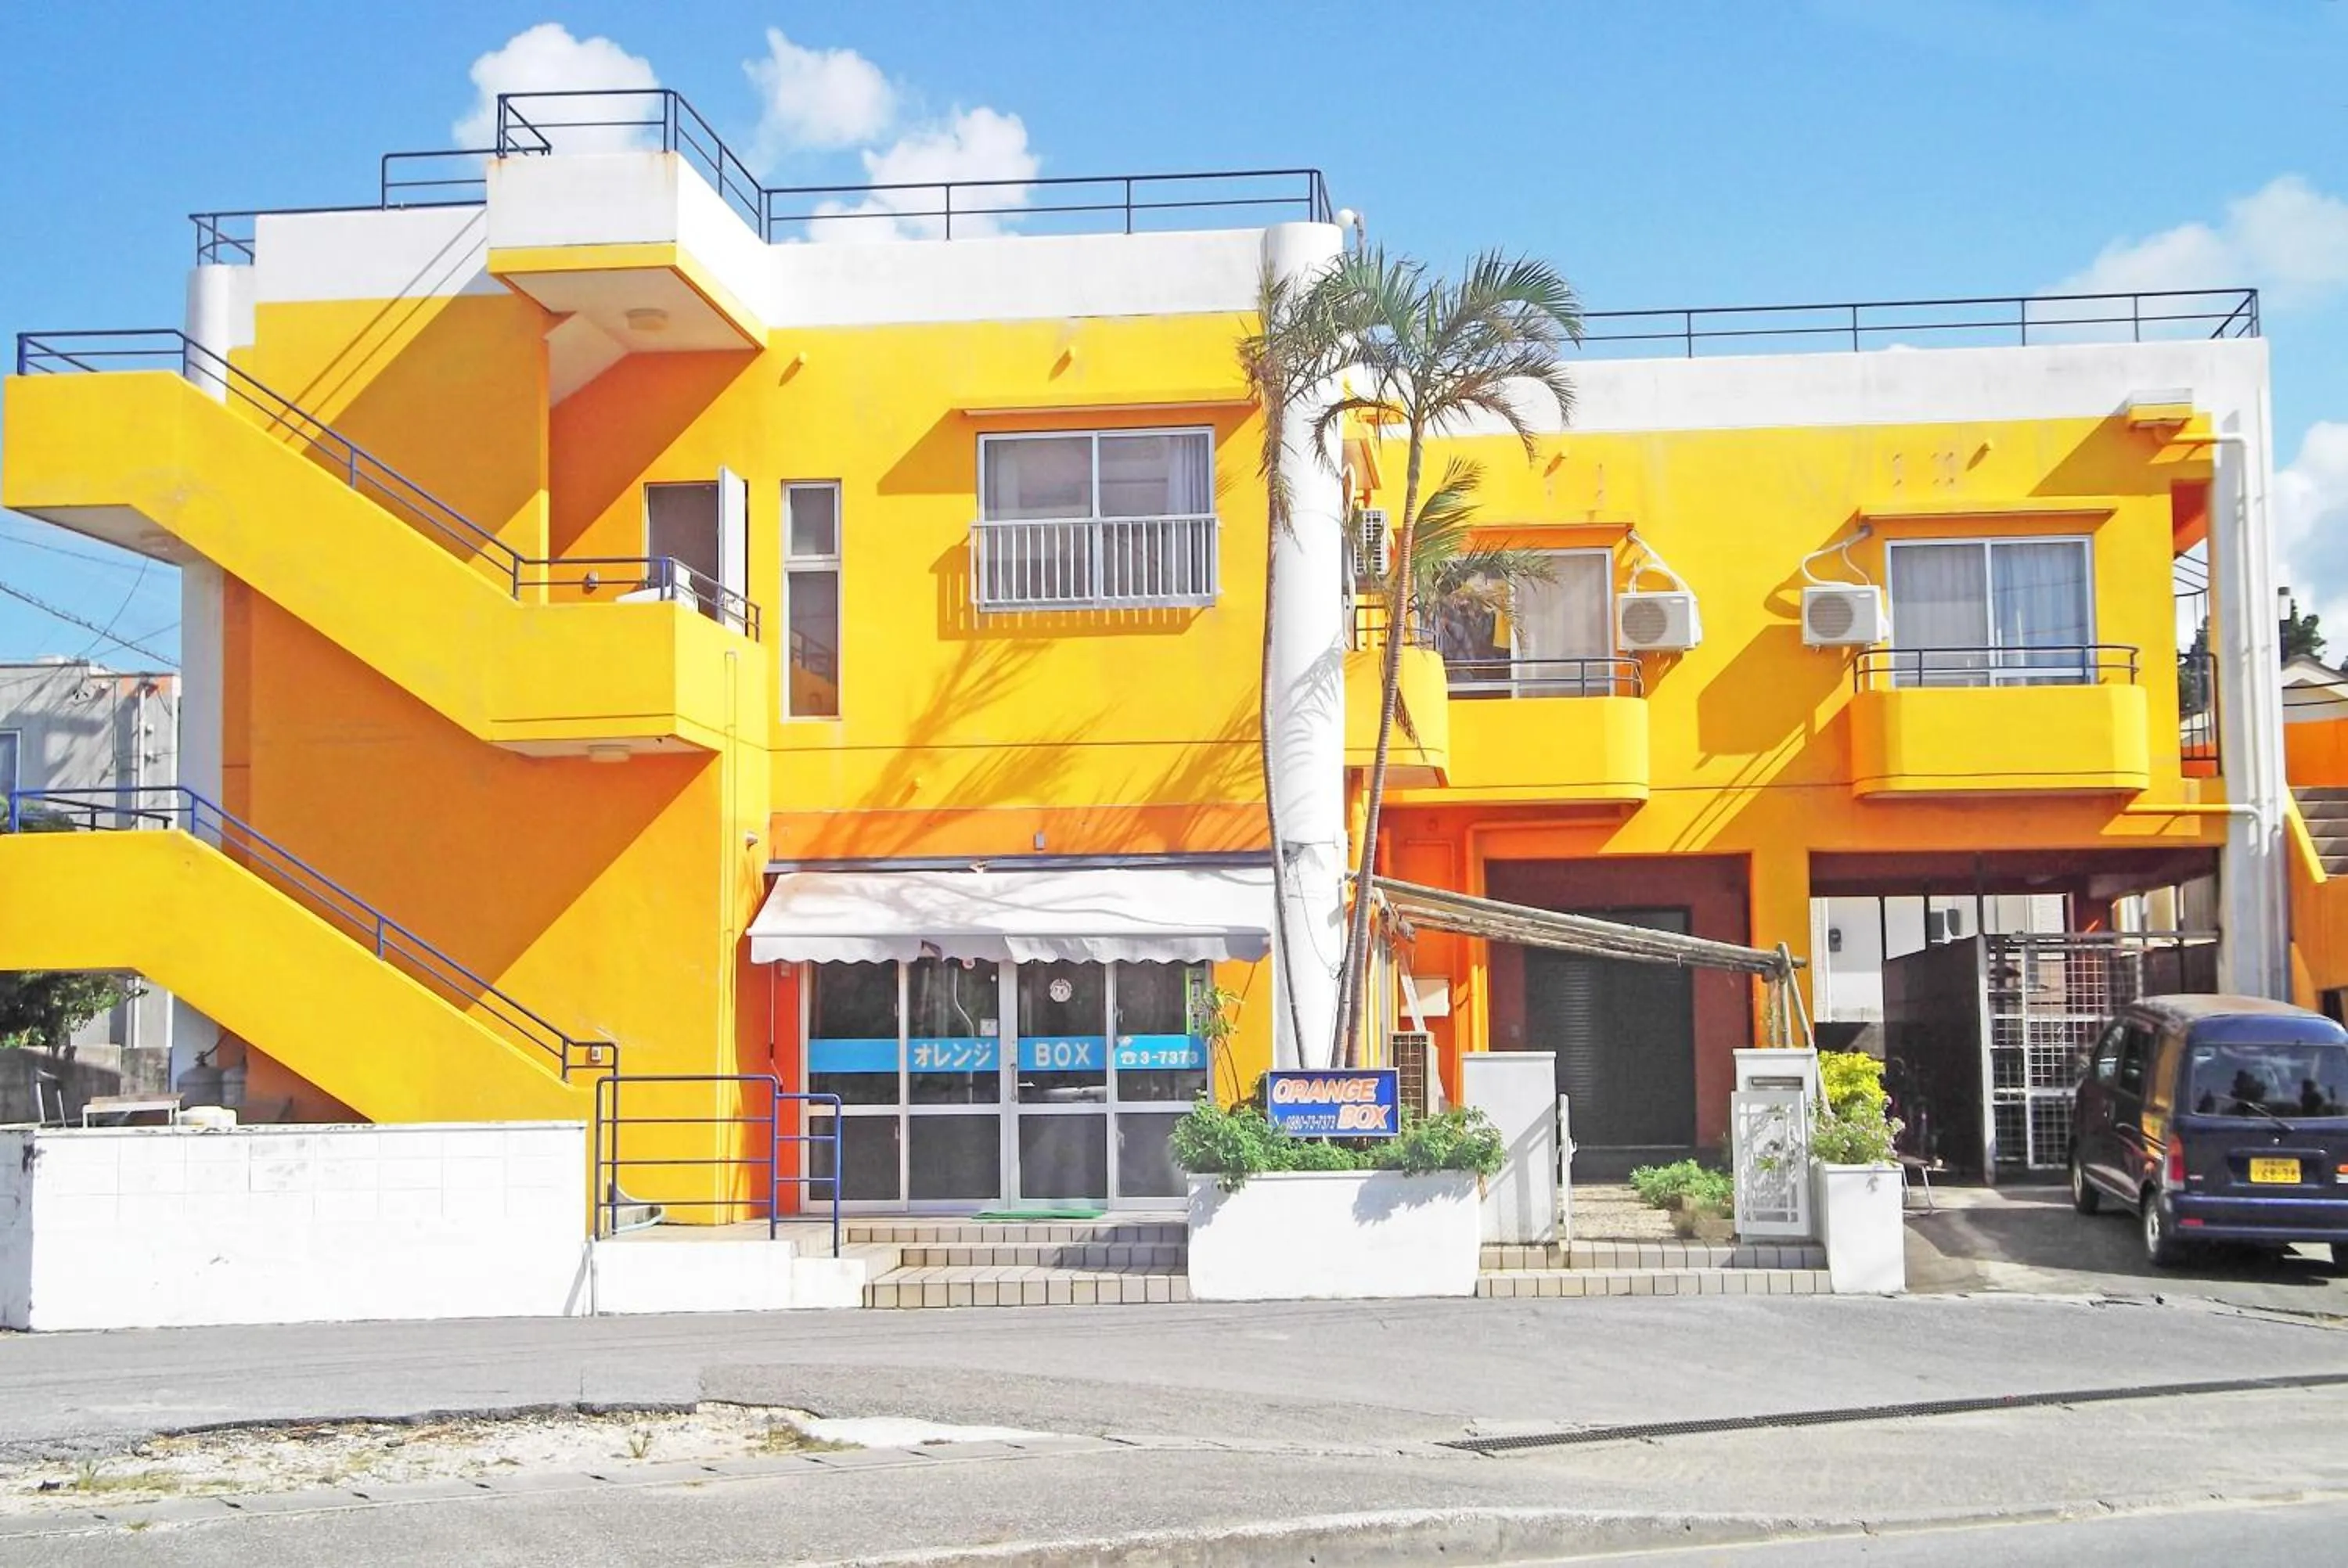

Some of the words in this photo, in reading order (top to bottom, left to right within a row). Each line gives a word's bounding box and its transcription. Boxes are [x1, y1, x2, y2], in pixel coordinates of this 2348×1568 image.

[913, 1042, 992, 1067] オレンジ
[1035, 1041, 1090, 1066] BOX
[1140, 1051, 1198, 1065] 3-7373
[1273, 1077, 1379, 1103] ORANGE
[1338, 1104, 1392, 1129] BOX
